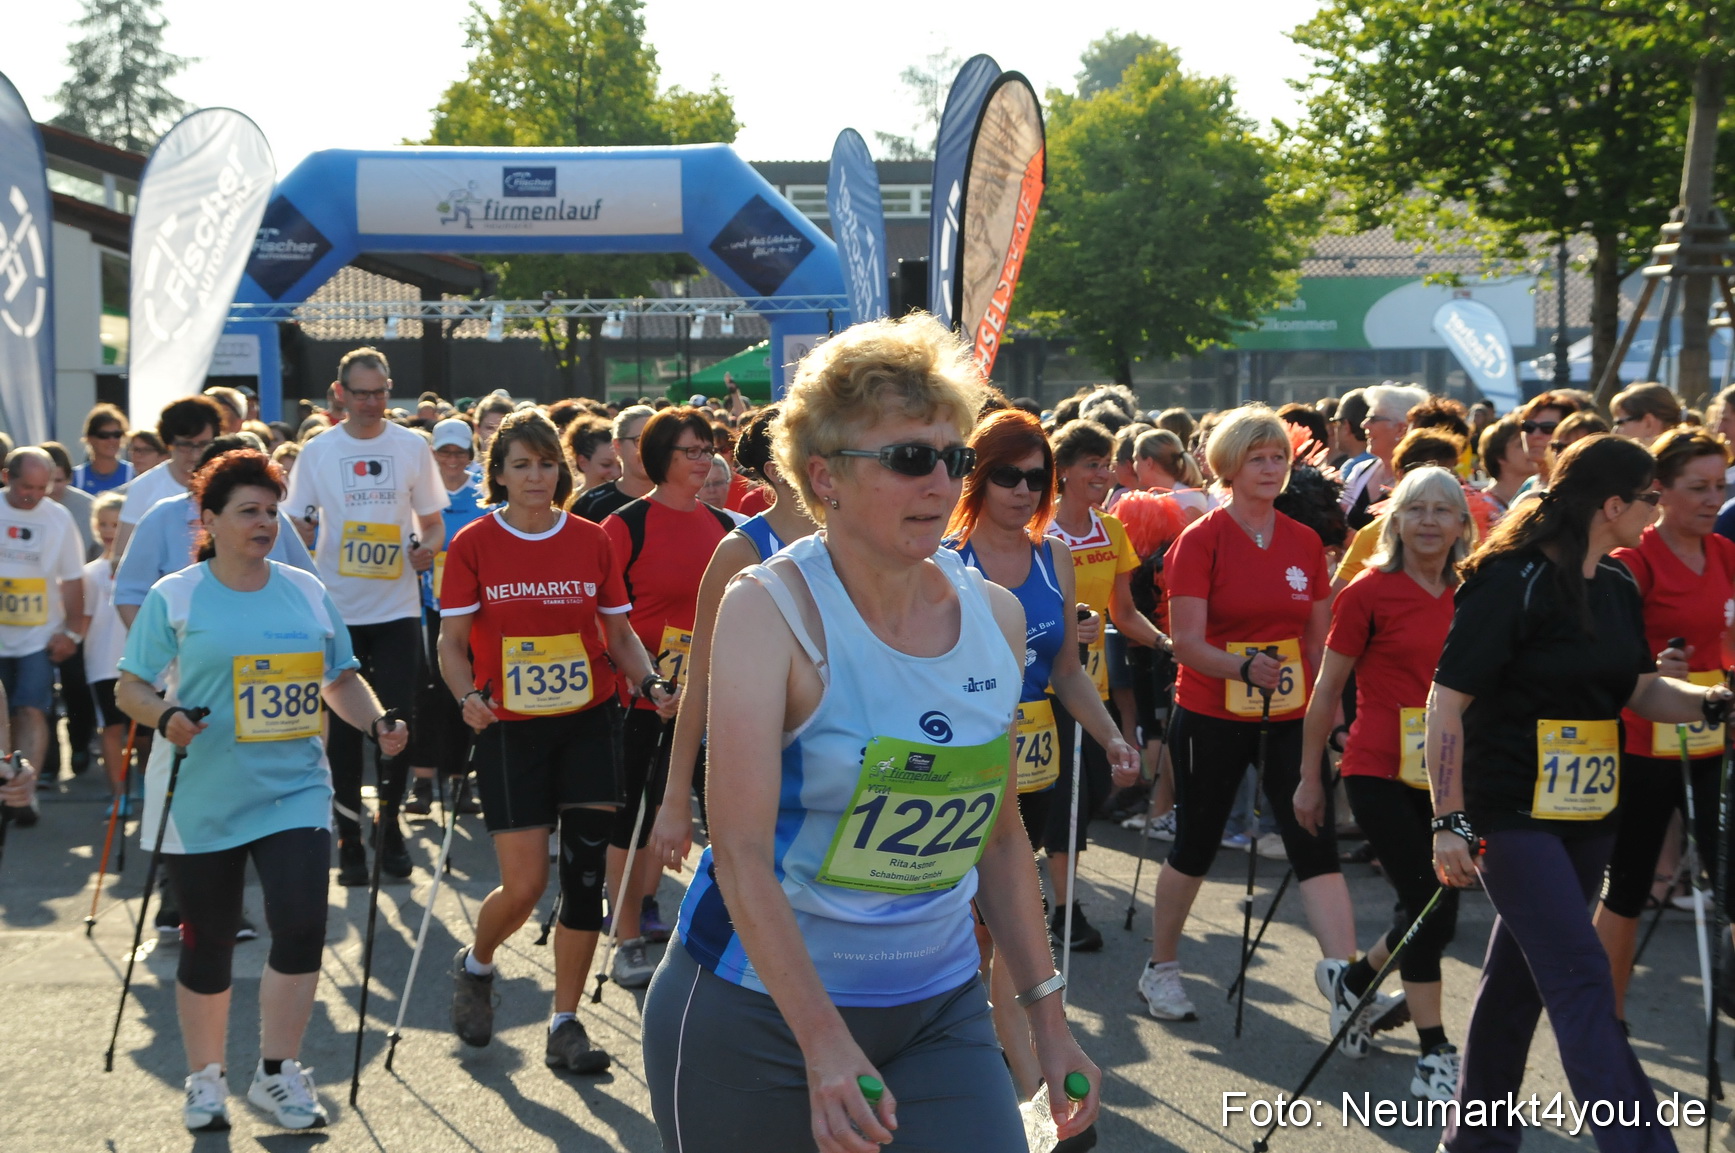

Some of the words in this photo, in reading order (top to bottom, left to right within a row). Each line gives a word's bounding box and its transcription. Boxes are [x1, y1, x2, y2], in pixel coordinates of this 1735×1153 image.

[484, 199, 602, 221] firmenlauf
[164, 143, 245, 312] Fischer
[344, 541, 400, 566] 1007
[1086, 550, 1118, 565] BÖGL
[486, 580, 581, 600] NEUMARKT
[1038, 620, 1056, 631] Bau
[507, 660, 589, 696] 1335
[239, 682, 320, 720] 1388
[889, 767, 953, 783] firmenlauf
[1543, 756, 1616, 794] 1123
[867, 783, 893, 795] run
[852, 793, 996, 857] 1222
[889, 858, 909, 869] Rita
[910, 859, 937, 870] Astner
[869, 869, 921, 882] Schabmüller
[923, 869, 943, 881] GmbH
